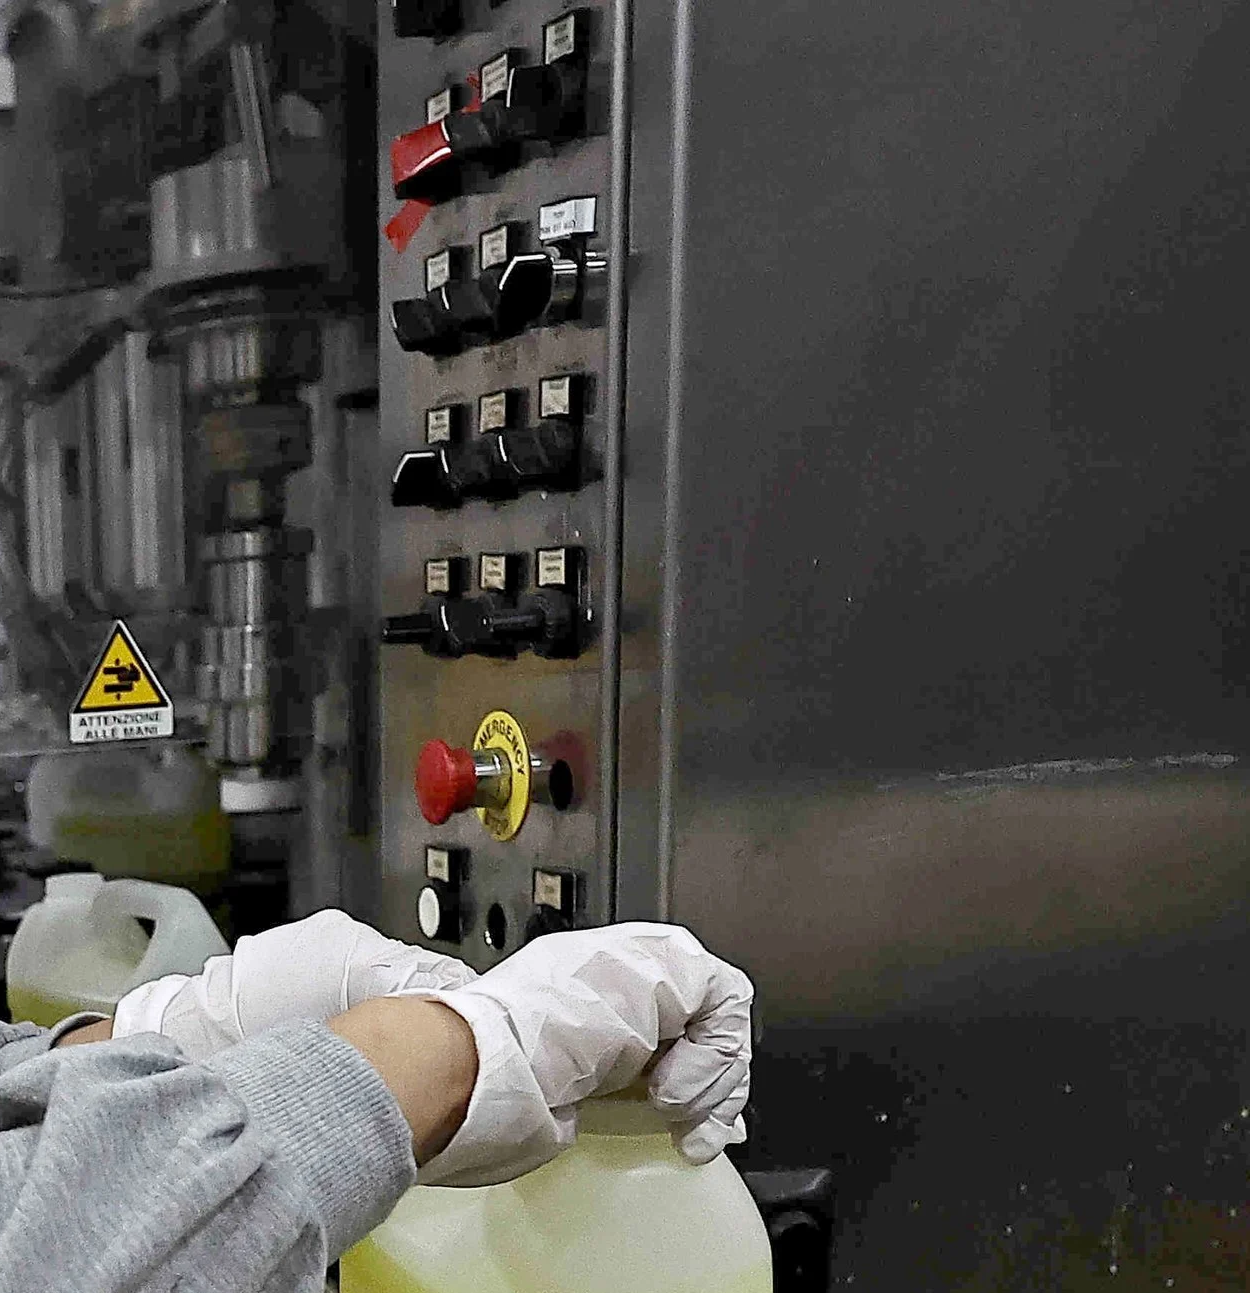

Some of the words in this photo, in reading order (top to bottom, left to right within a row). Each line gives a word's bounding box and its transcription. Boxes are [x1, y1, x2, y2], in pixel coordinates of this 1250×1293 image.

[79, 711, 160, 726] ATTENZIONE
[85, 728, 118, 739] ALLE
[123, 726, 159, 737] MANI
[477, 719, 526, 776] MERGENCY
